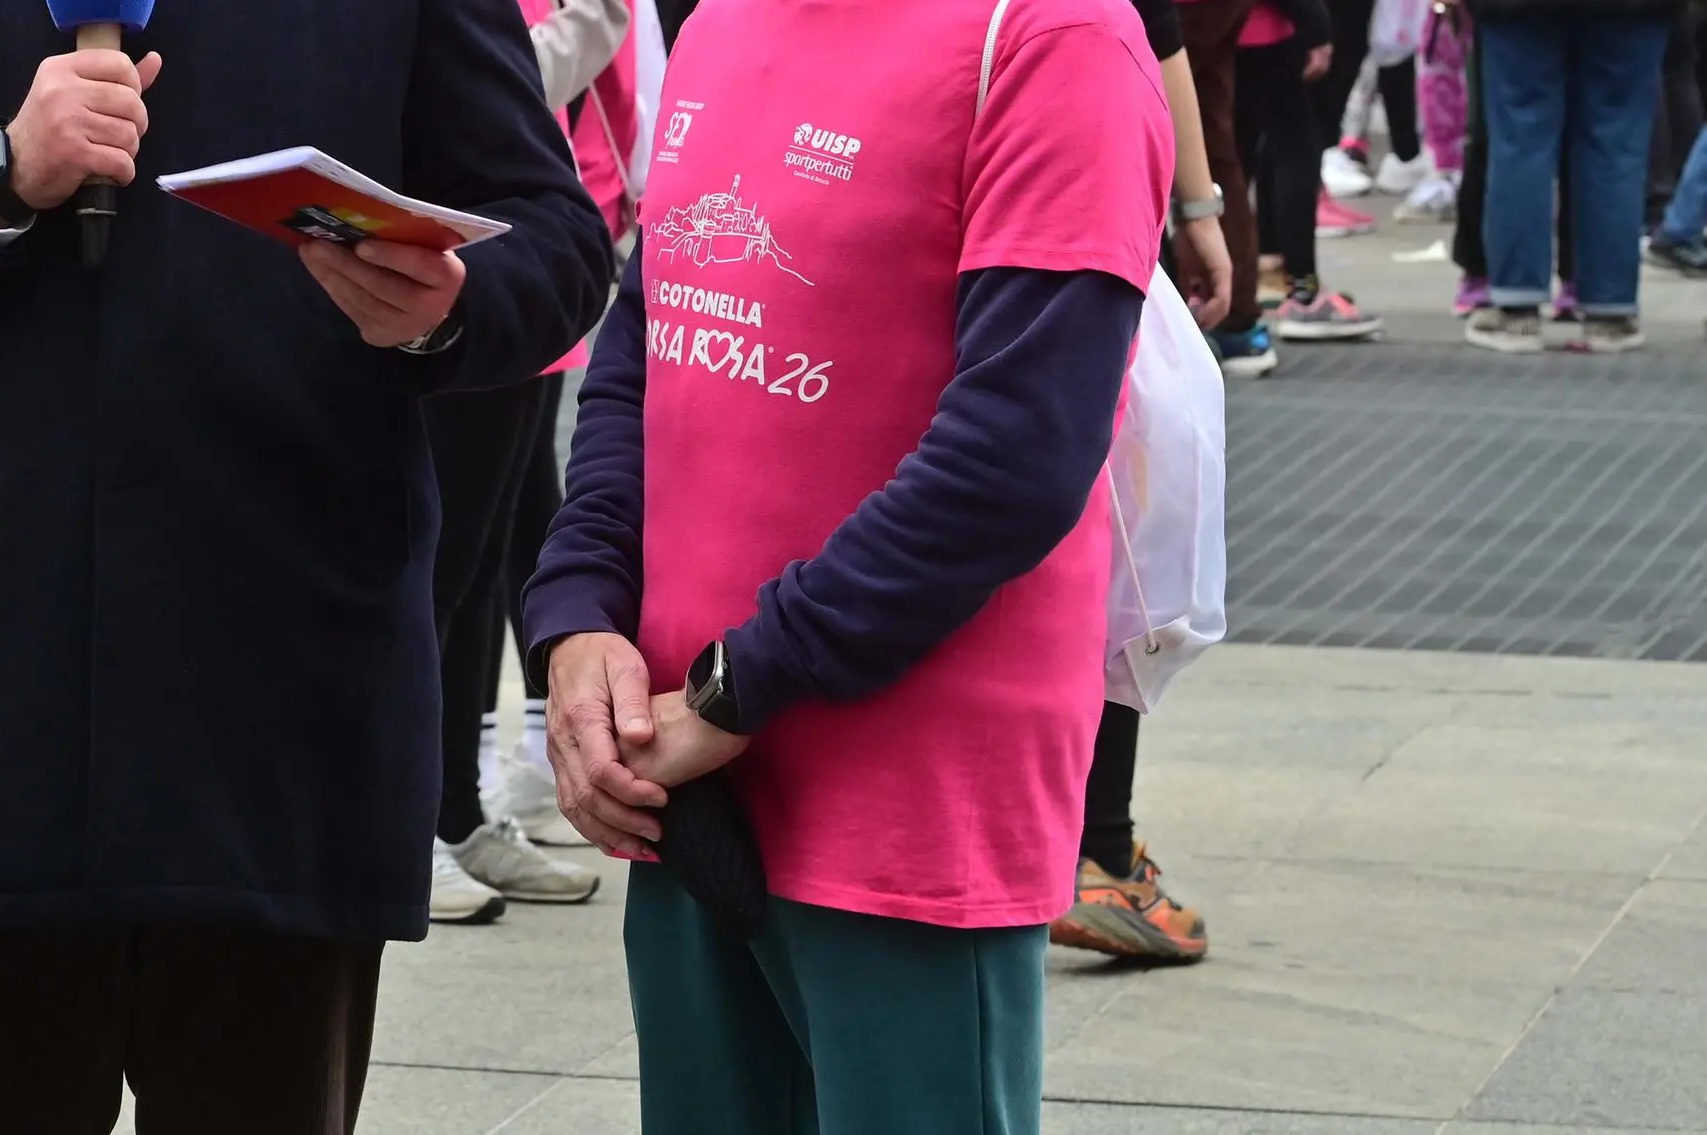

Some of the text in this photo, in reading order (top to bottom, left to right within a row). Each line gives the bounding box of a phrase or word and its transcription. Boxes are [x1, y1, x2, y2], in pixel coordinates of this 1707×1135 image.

[811, 129, 862, 157] UISP
[783, 151, 852, 181] sportpertutti
[660, 281, 762, 328] COTONELLA
[646, 317, 684, 366] ORSA
[767, 353, 834, 403] 26
